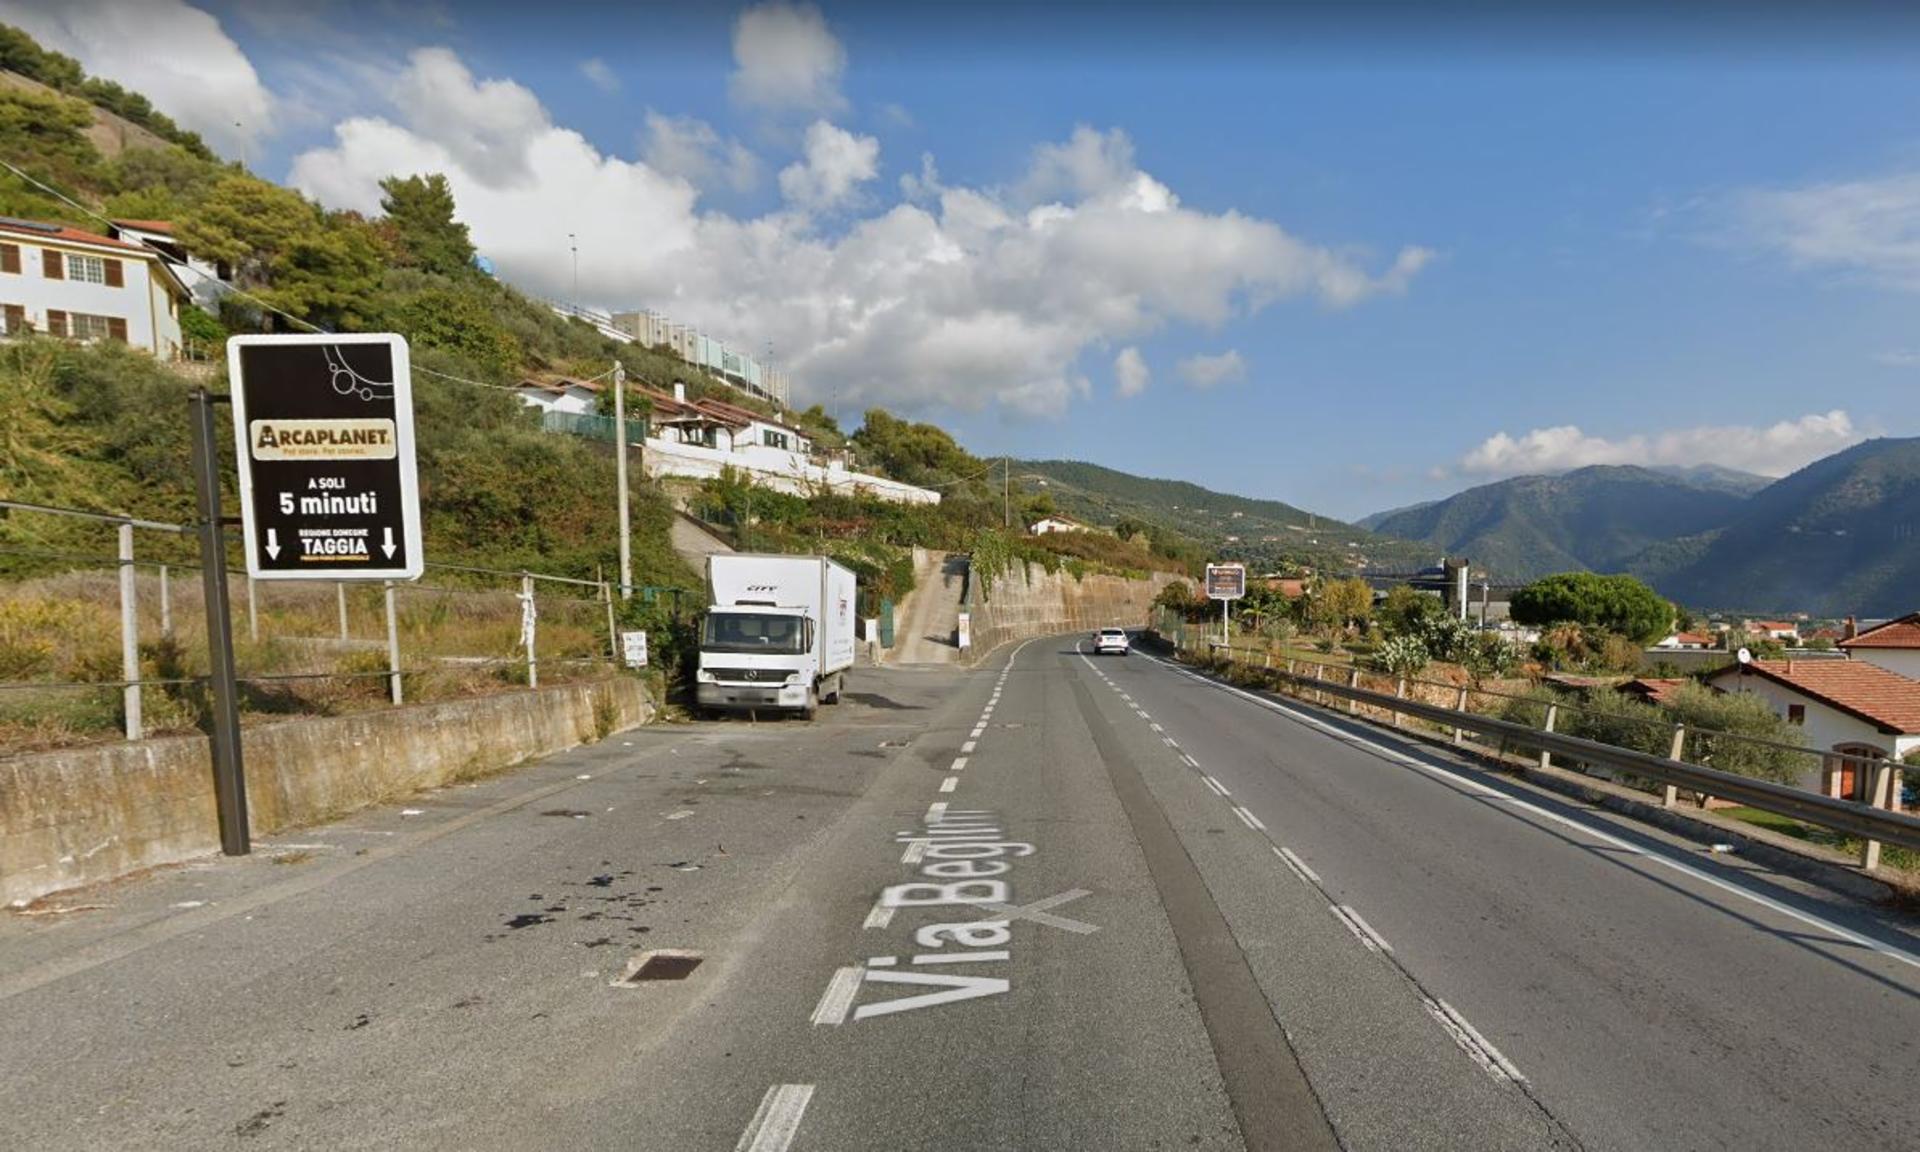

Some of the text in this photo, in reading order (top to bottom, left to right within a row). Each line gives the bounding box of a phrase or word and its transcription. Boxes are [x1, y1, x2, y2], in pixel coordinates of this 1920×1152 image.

[257, 425, 388, 448] ARCAPLANET
[308, 477, 345, 489] A SOLI
[279, 491, 377, 515] 5 minuti
[301, 538, 368, 554] TAGGIA
